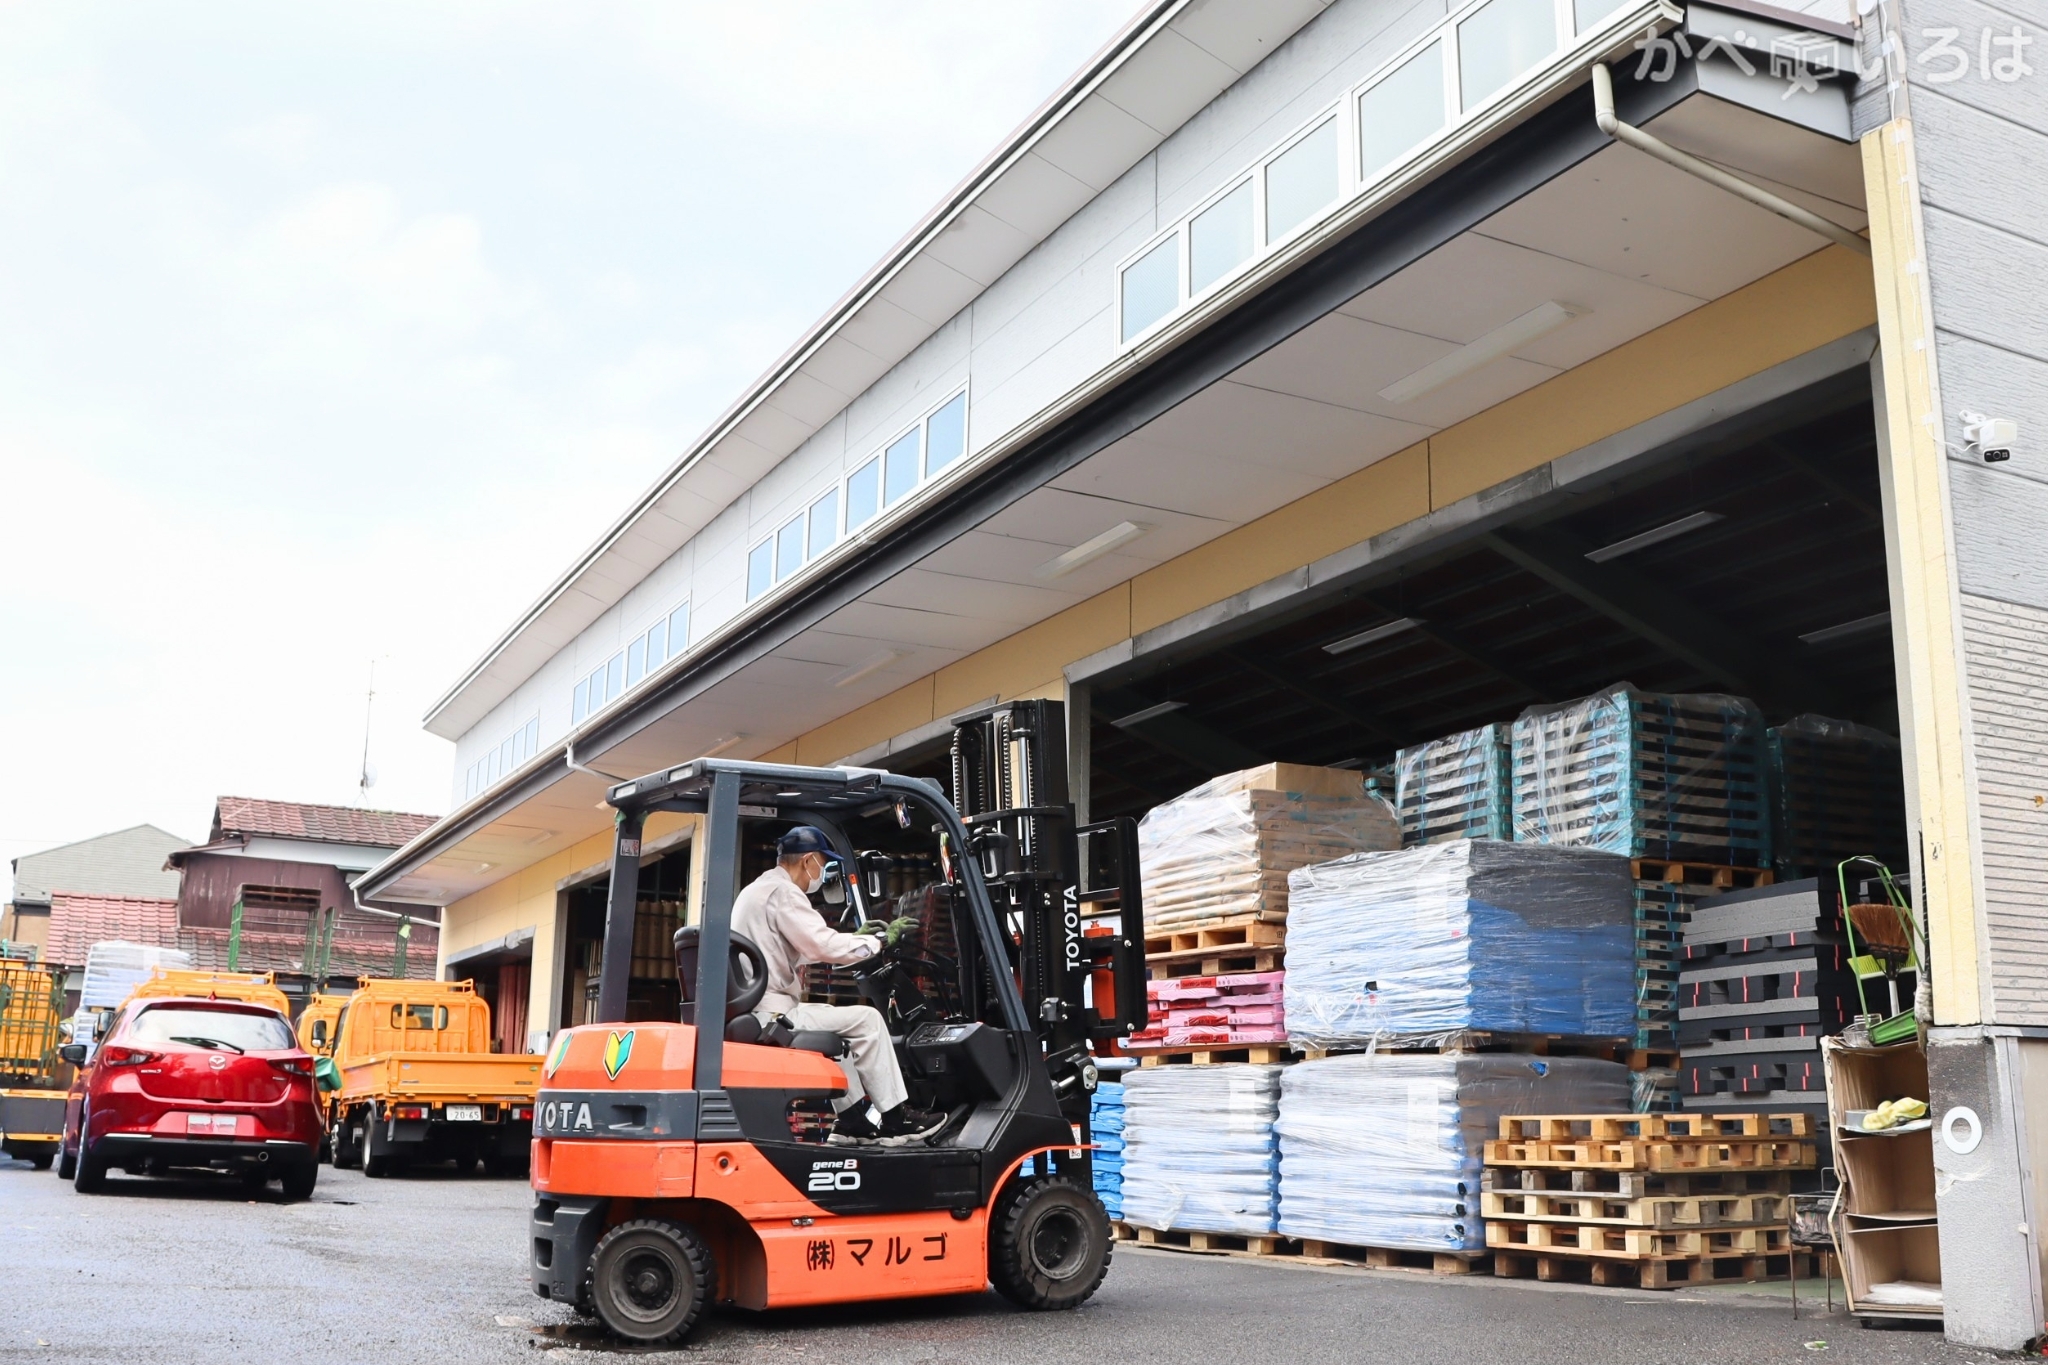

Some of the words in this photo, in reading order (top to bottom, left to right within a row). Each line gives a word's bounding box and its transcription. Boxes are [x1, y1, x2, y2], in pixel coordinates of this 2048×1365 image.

[1063, 884, 1080, 972] TOYOTA
[535, 1101, 594, 1131] YOTA
[808, 1171, 861, 1192] 20
